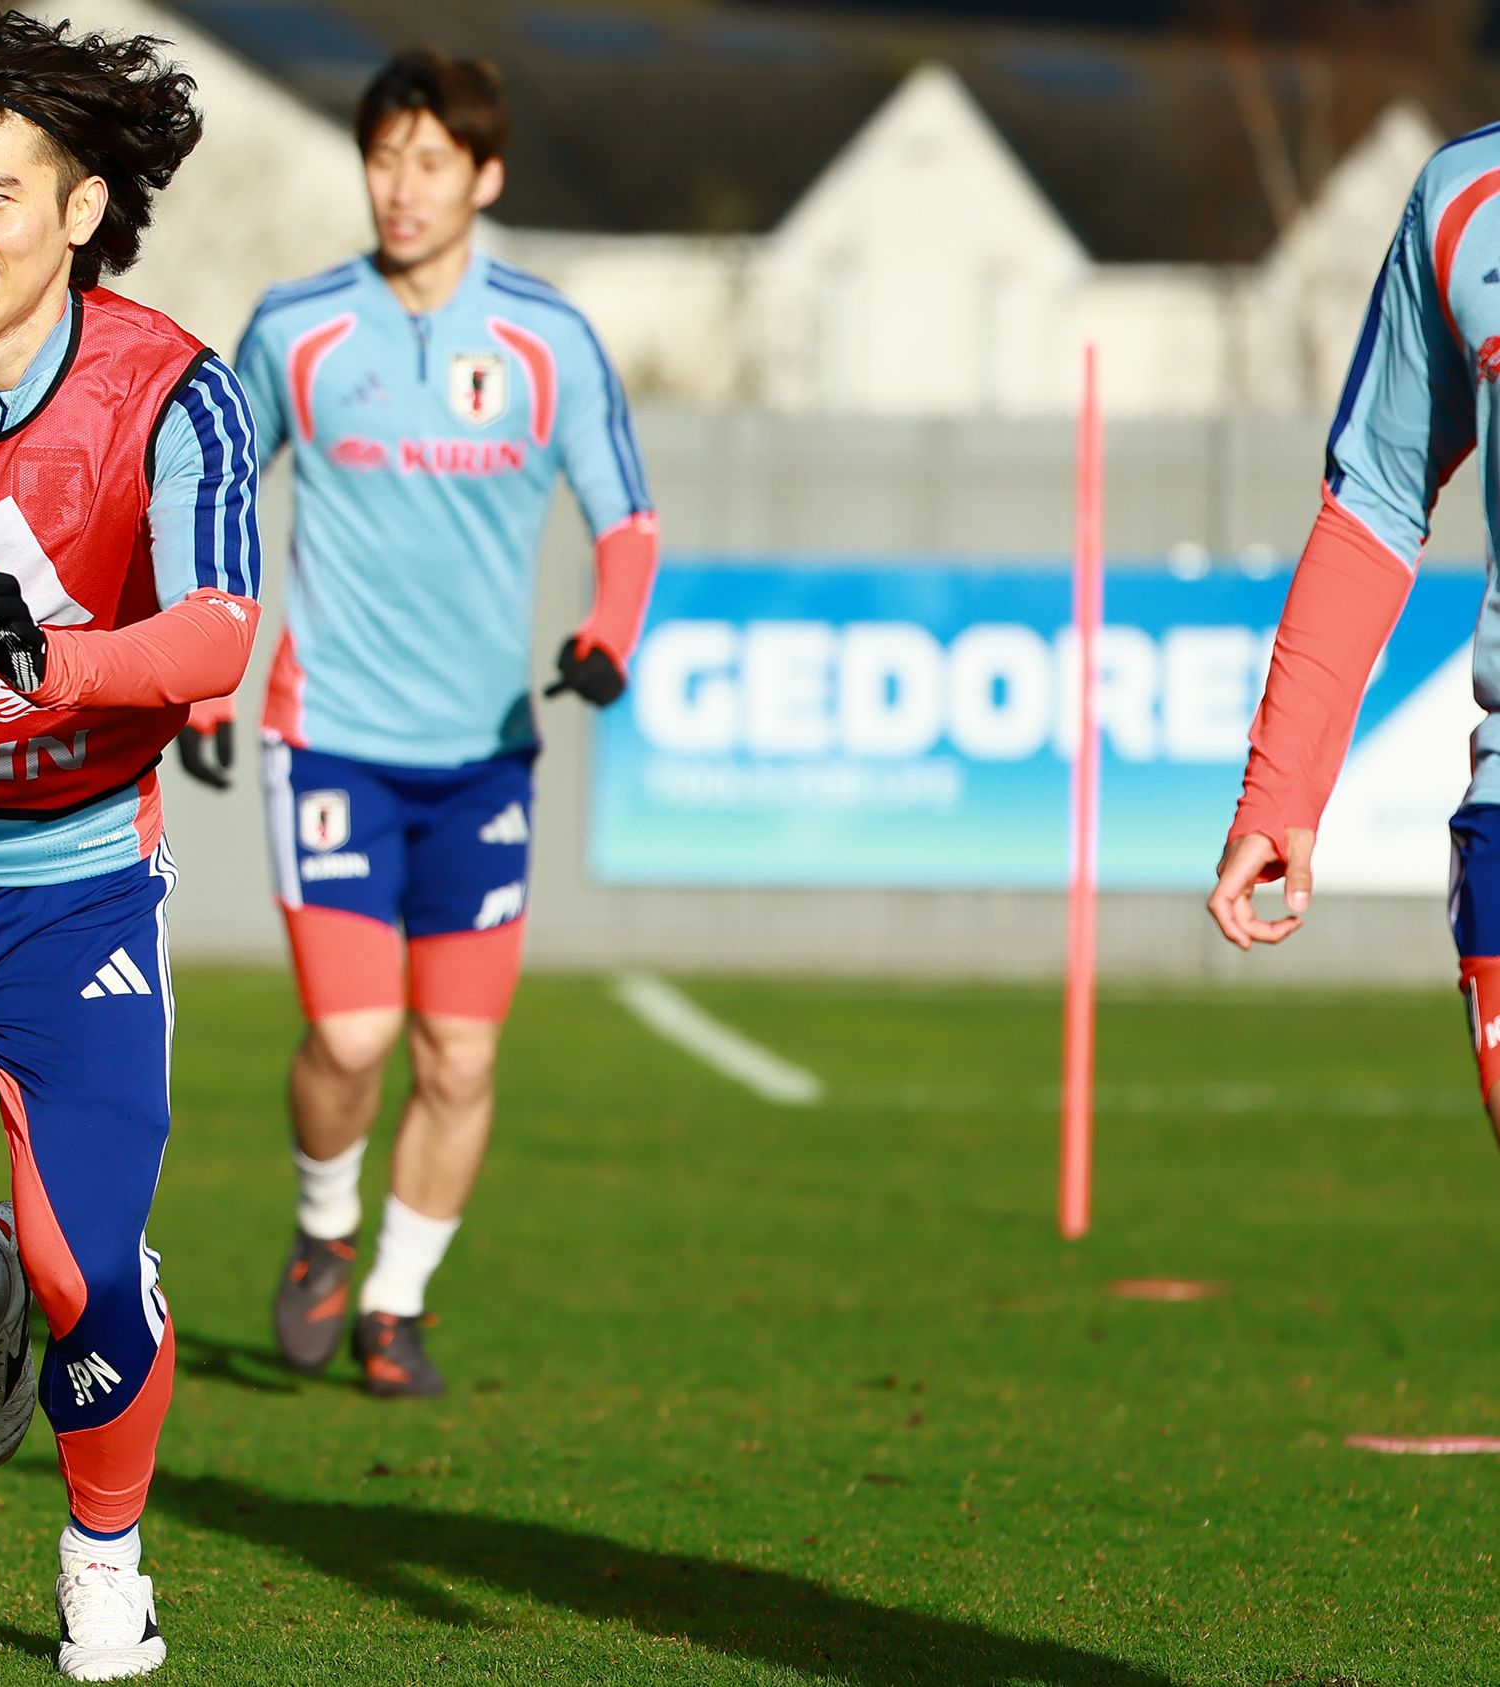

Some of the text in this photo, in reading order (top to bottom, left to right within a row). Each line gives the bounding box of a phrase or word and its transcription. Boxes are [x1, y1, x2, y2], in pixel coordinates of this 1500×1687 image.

[402, 439, 524, 474] KIRIN
[78, 831, 123, 850] FORMOTION
[67, 1351, 122, 1406] JPN
